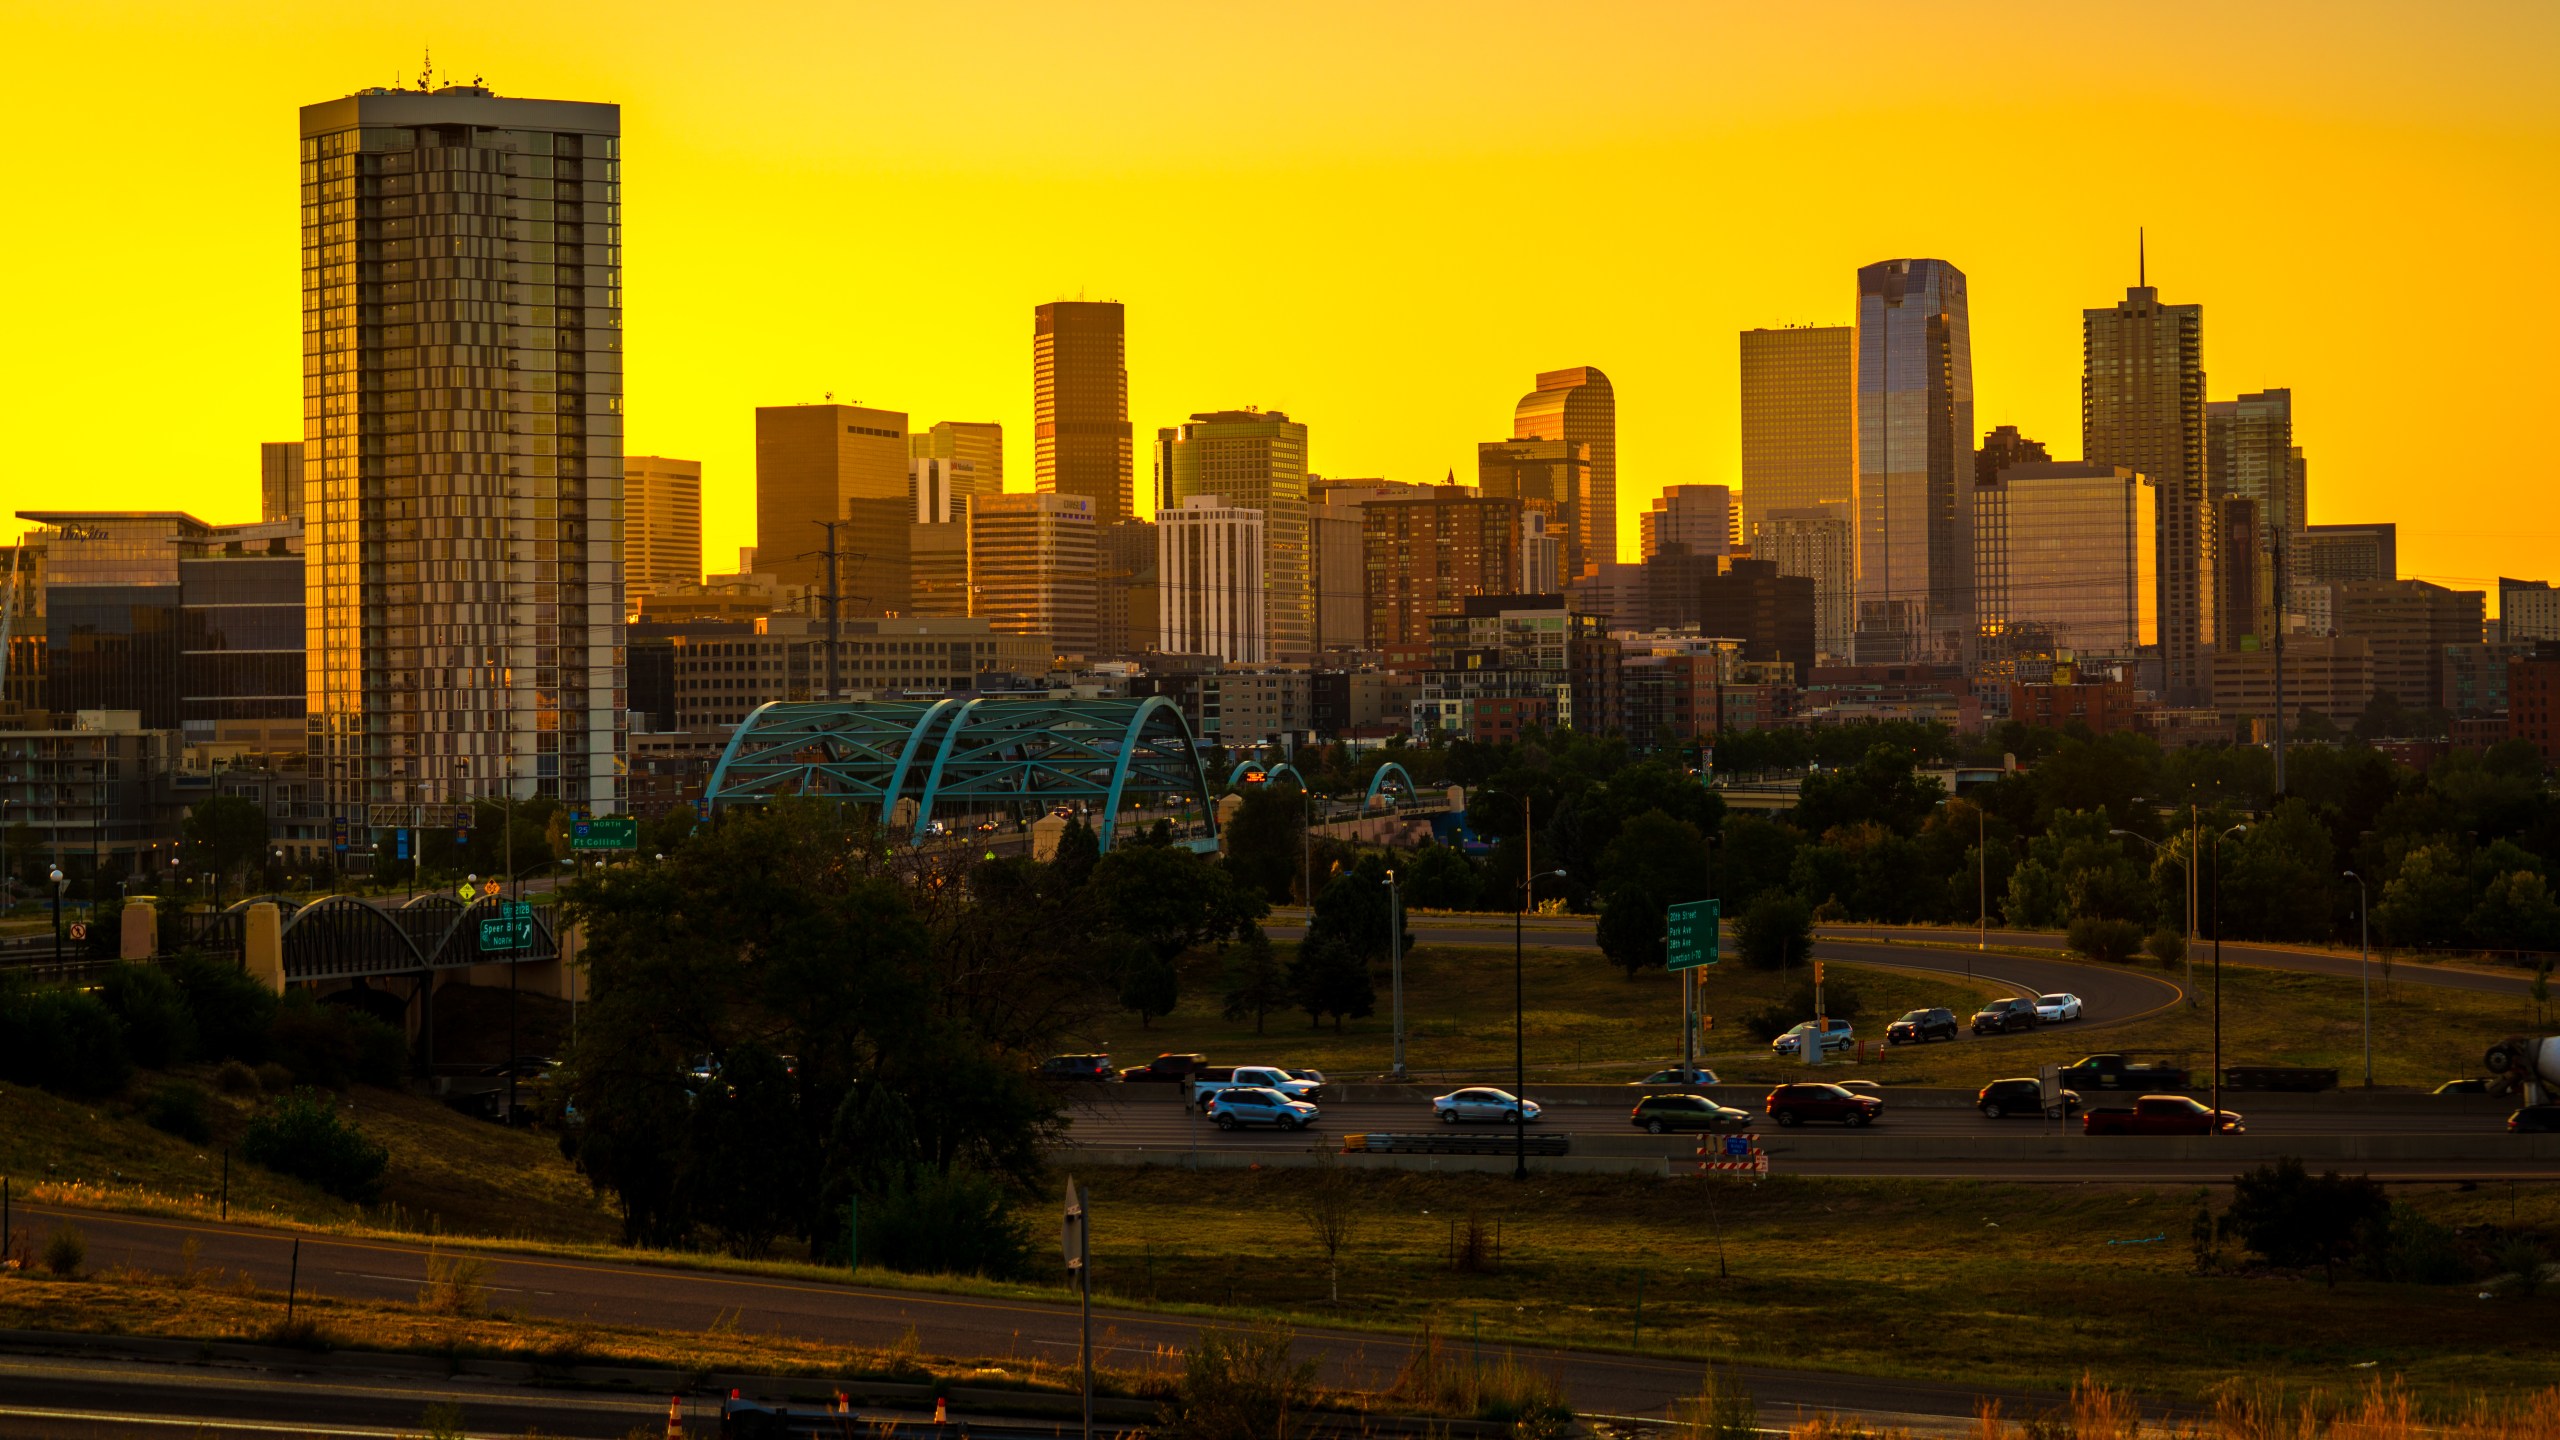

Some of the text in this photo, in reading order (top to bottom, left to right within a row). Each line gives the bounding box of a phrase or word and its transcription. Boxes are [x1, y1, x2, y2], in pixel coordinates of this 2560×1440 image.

[59, 523, 109, 543] DaVita
[578, 826, 588, 834] 25
[574, 838, 622, 846] Ft Collins
[515, 905, 530, 914] 212B
[1669, 911, 1681, 922] 20th
[1682, 909, 1697, 920] Street
[484, 923, 504, 935] Speer
[1669, 925, 1692, 937] Park Ave
[1682, 938, 1692, 948] Ave
[1669, 950, 1691, 964] Junction
[1691, 949, 1702, 960] I-70
